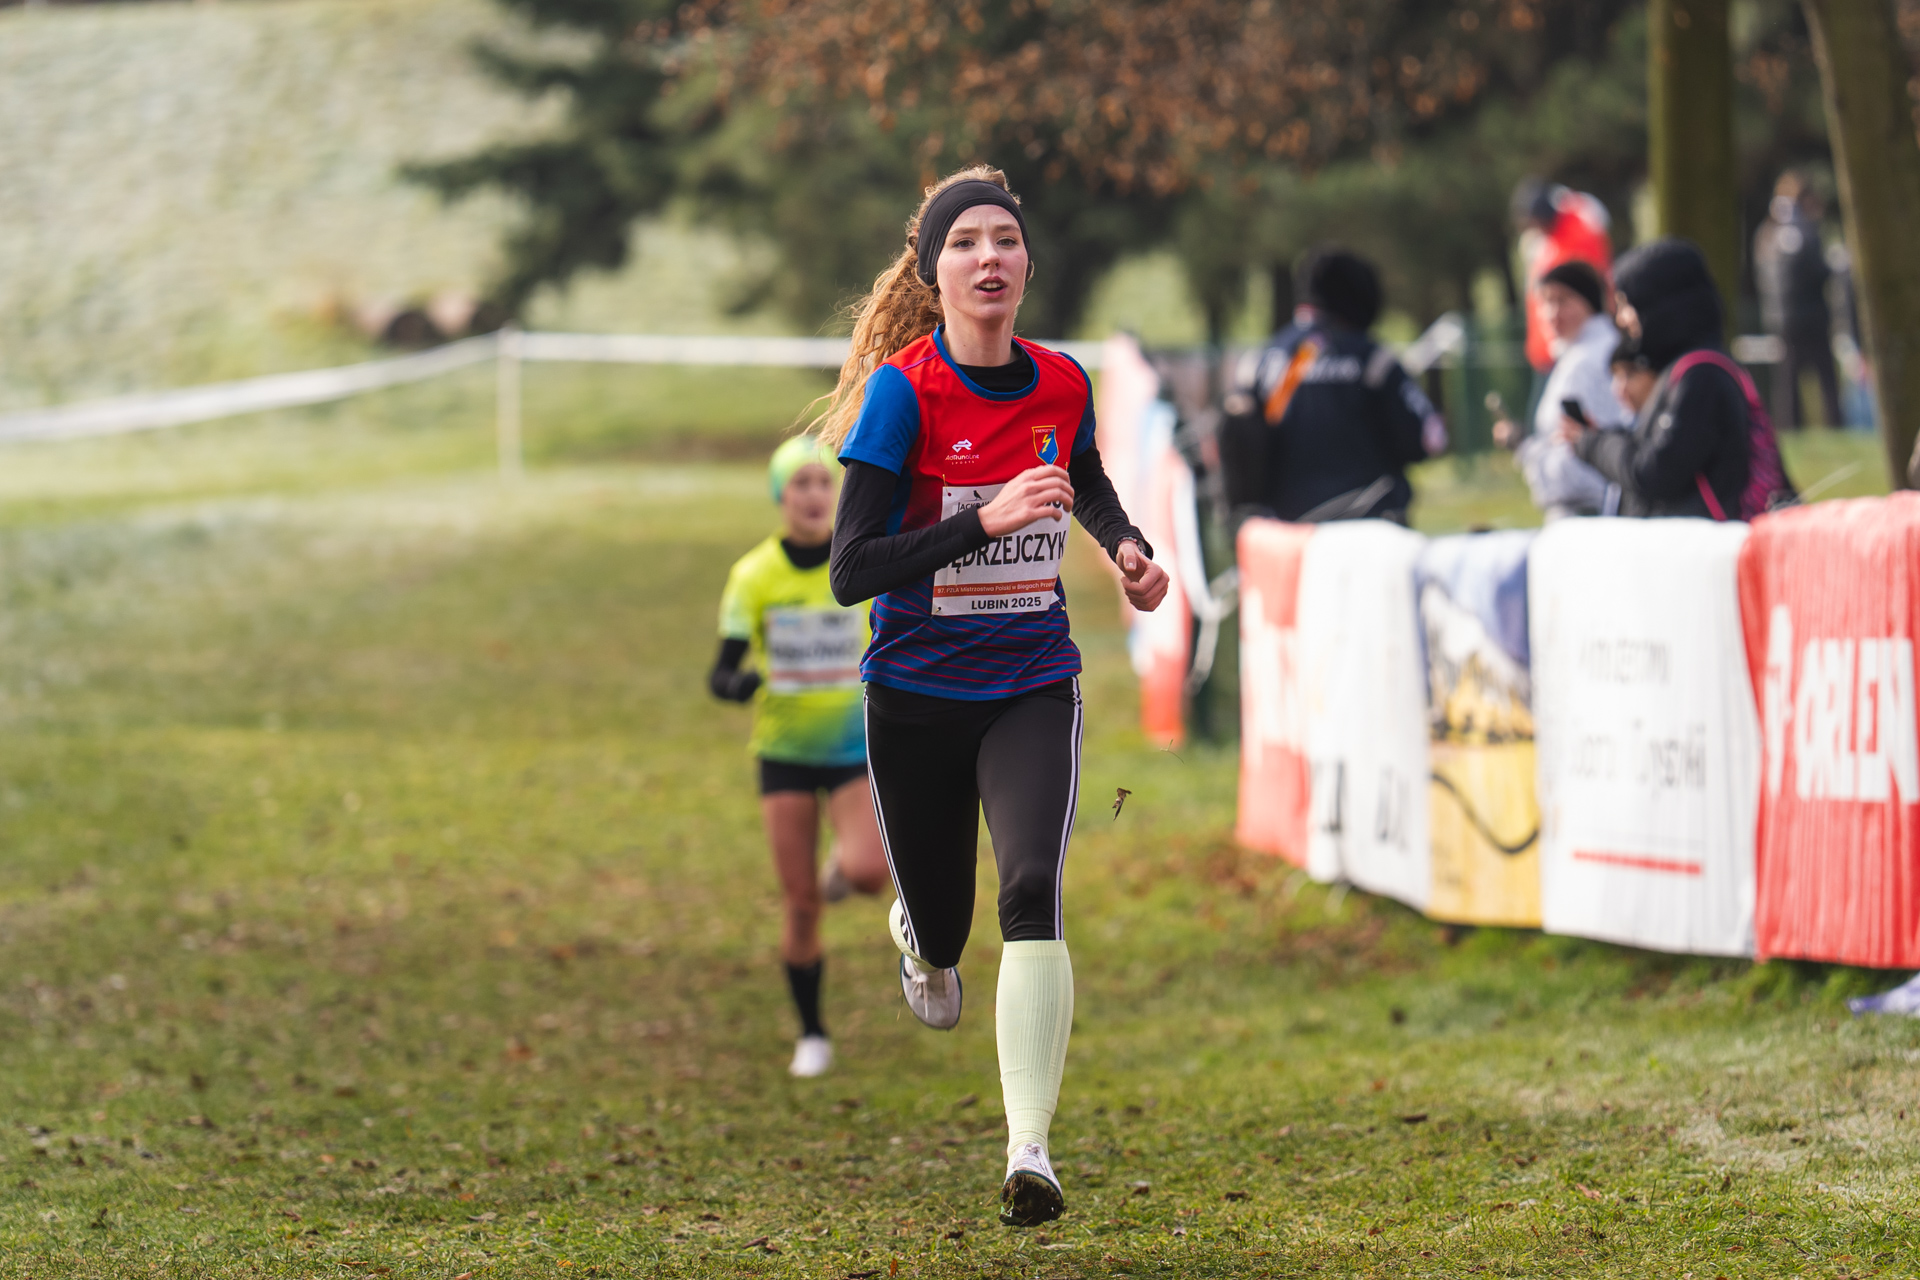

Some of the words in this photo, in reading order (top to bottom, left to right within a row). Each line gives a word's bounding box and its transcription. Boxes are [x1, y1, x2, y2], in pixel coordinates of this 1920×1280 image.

[951, 530, 1067, 574] DRZEJCZYK
[960, 585, 994, 593] Mistrzostwa
[995, 583, 1011, 591] Polski
[1017, 582, 1040, 591] Biegach
[971, 599, 1009, 610] LUBIN
[1011, 596, 1042, 608] 2025
[1795, 636, 1919, 803] ORLEN
